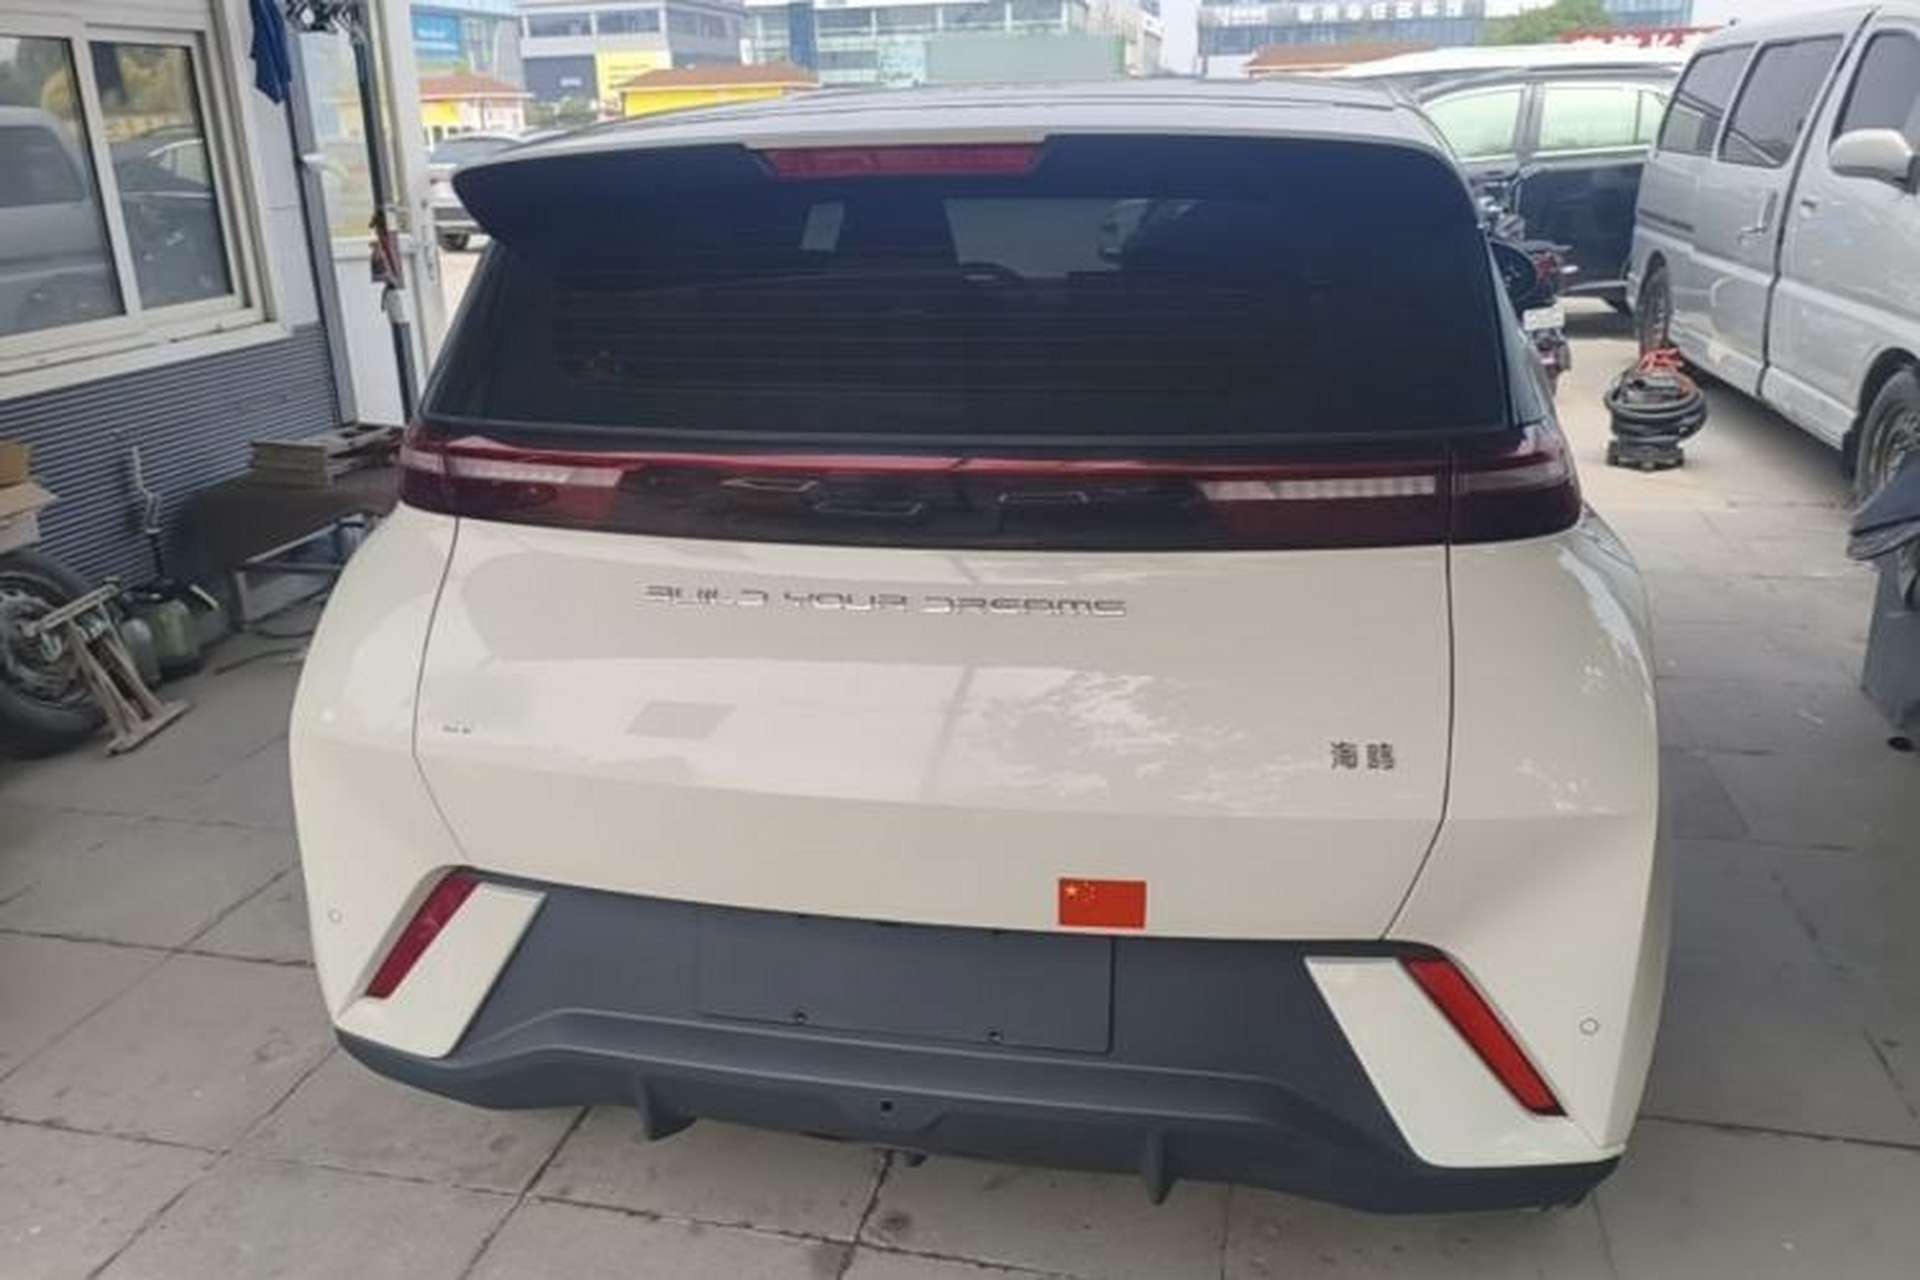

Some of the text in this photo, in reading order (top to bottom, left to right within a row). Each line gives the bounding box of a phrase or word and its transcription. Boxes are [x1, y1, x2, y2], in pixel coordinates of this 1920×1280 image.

[643, 584, 1127, 617] BUILD YOUR DREAMS
[1330, 740, 1395, 771] 海鸥
